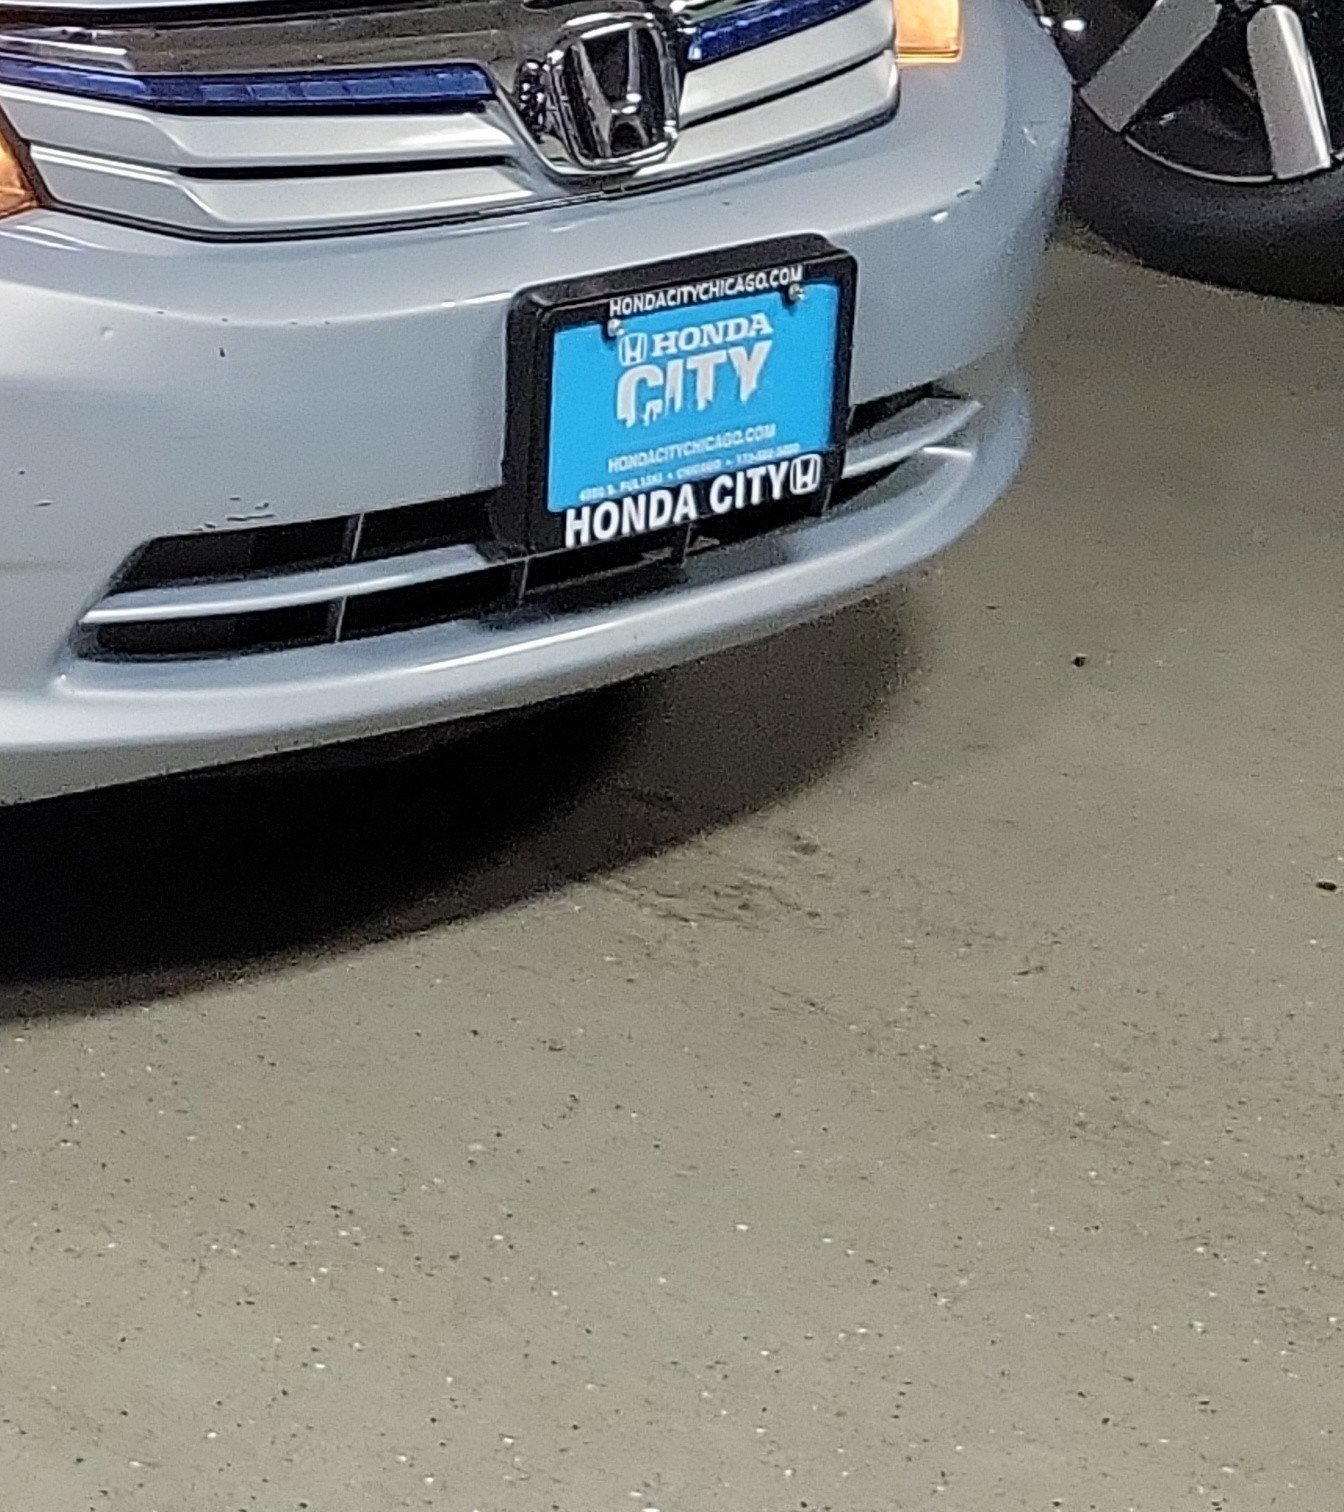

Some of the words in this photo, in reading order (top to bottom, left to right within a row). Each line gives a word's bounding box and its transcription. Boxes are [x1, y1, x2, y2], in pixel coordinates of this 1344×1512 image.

[609, 264, 803, 317] HONDACITYCHICAGO.COM
[652, 312, 774, 357] HONDA
[617, 340, 773, 428] CITY
[565, 484, 698, 548] HONDA
[709, 460, 791, 514] CITY
